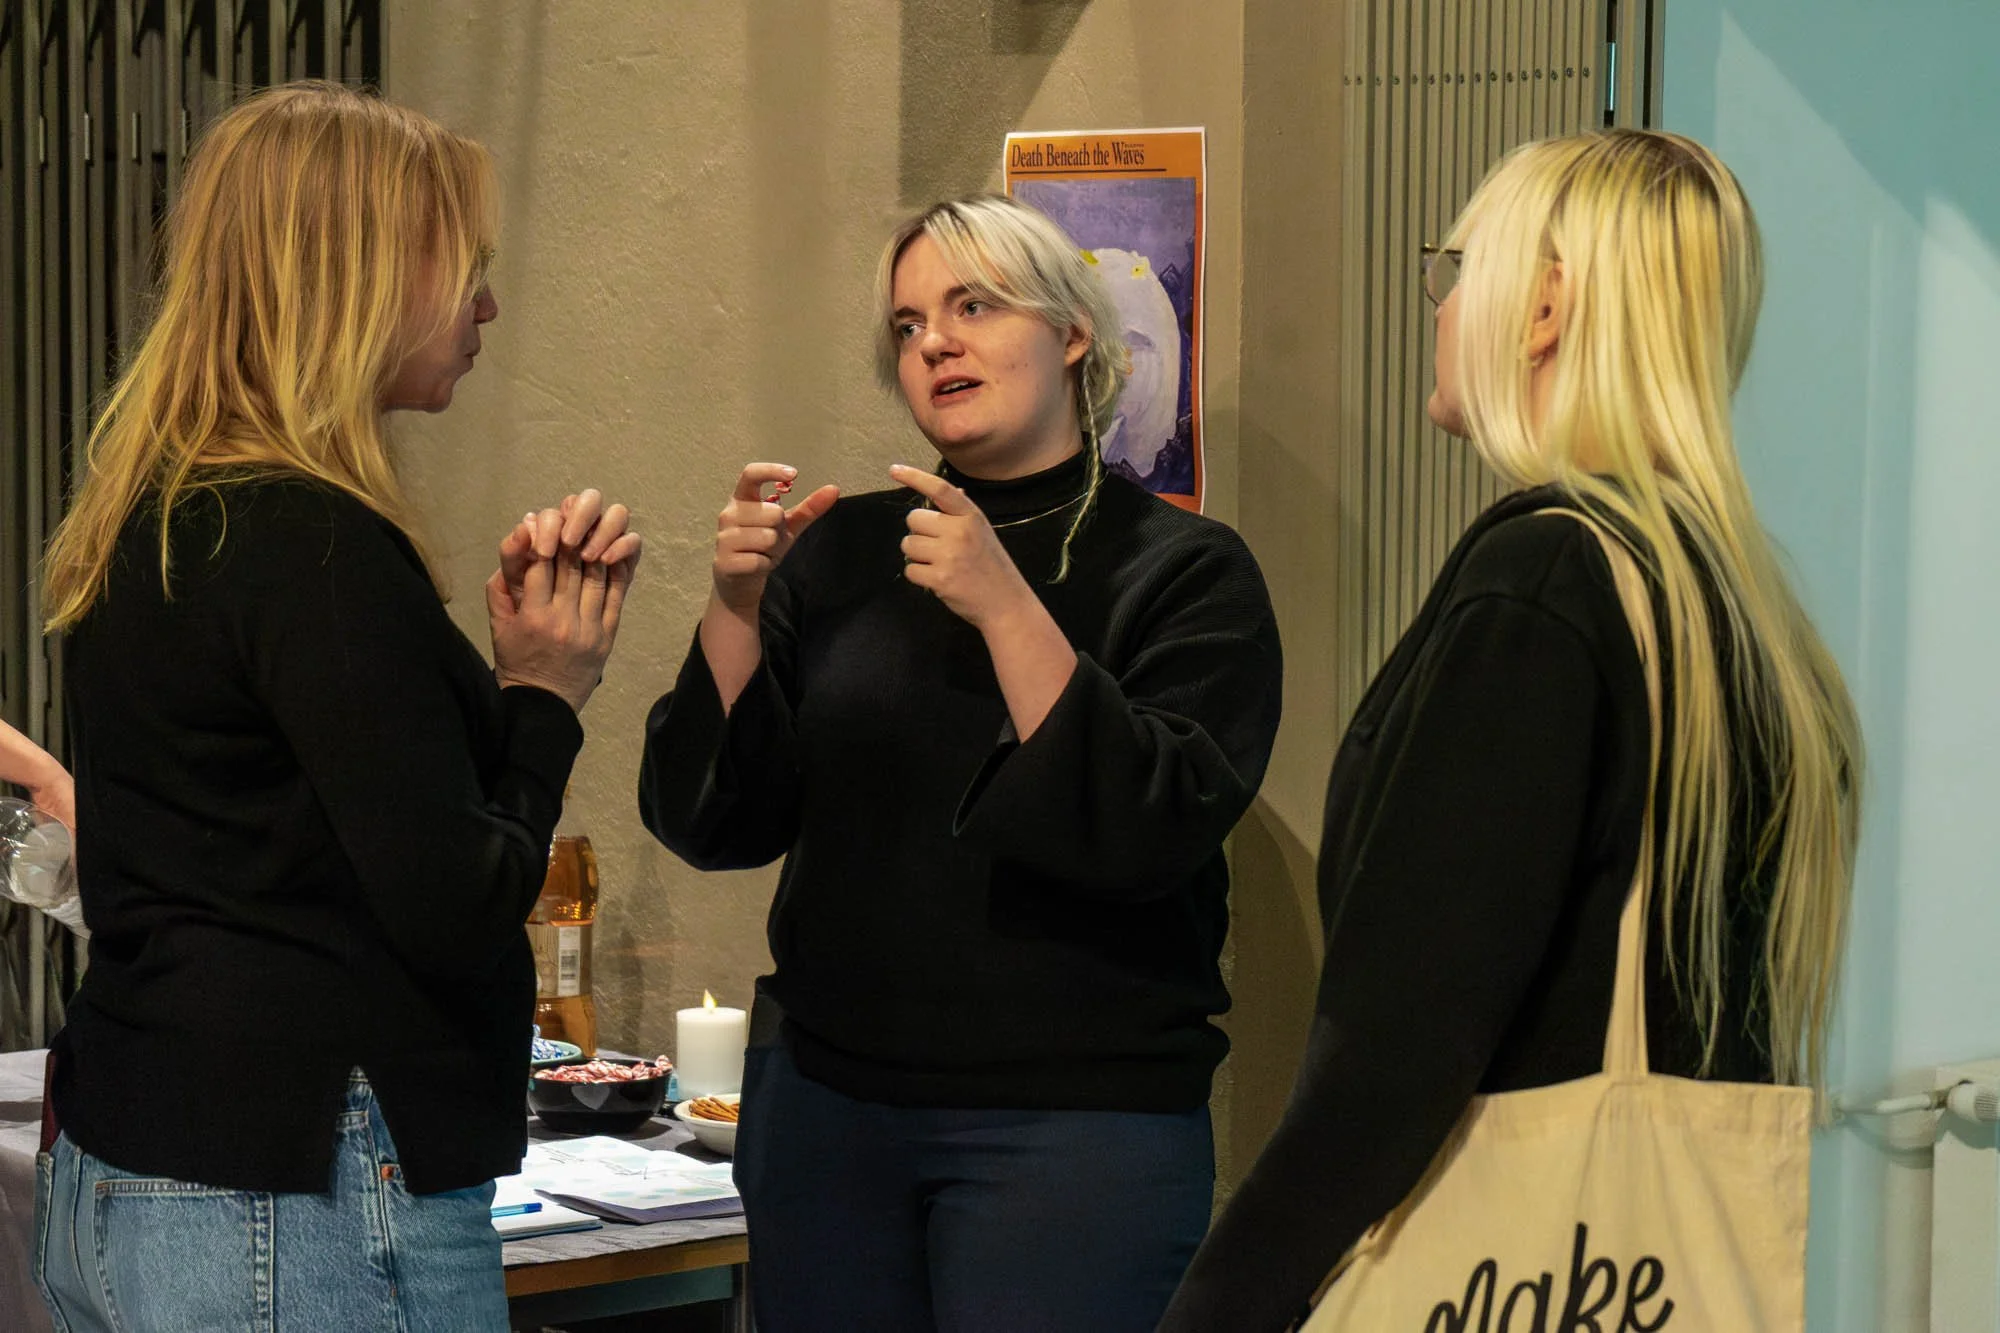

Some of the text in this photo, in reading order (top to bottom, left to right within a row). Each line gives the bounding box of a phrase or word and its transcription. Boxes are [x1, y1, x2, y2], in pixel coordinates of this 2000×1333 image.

[1012, 141, 1145, 167] Death Beneath the Waves
